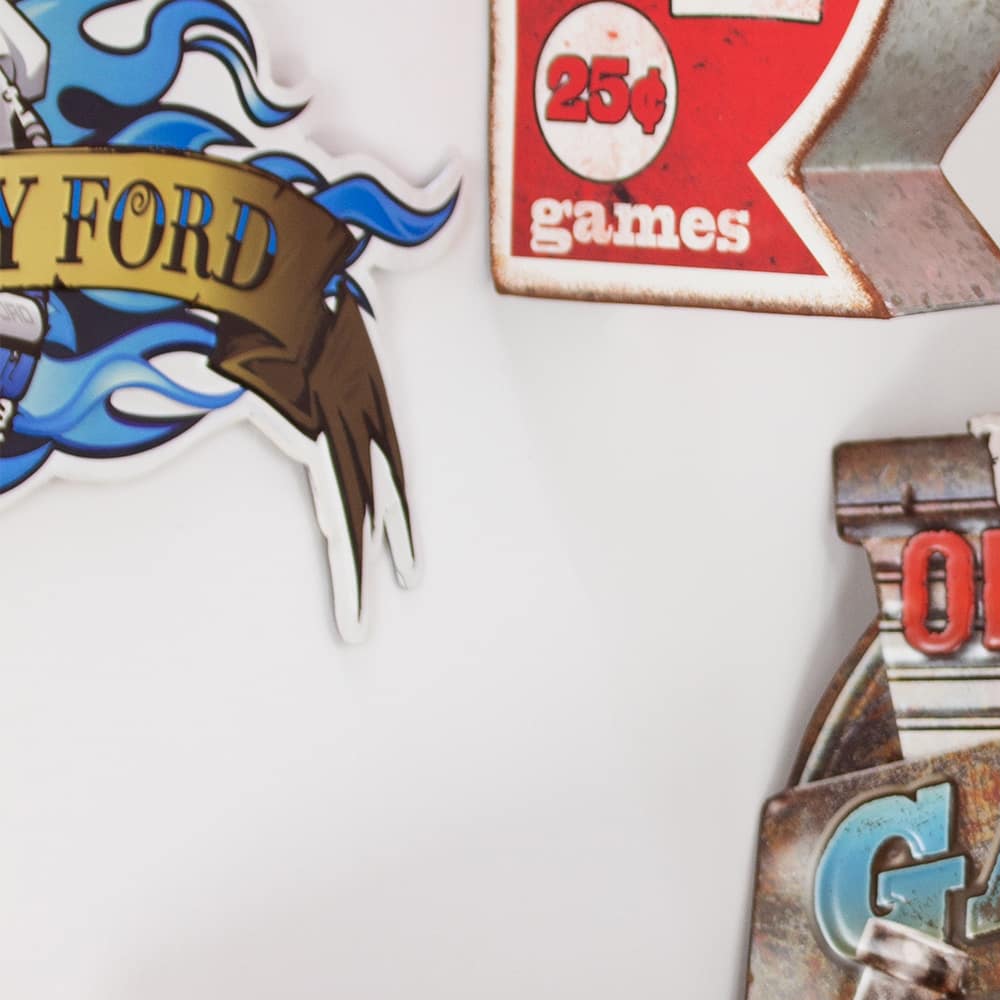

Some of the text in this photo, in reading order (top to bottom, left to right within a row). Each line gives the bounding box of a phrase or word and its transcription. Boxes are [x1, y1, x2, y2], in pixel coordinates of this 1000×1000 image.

[545, 55, 668, 135] 25¢
[55, 175, 279, 292] FORD
[529, 197, 751, 255] games
